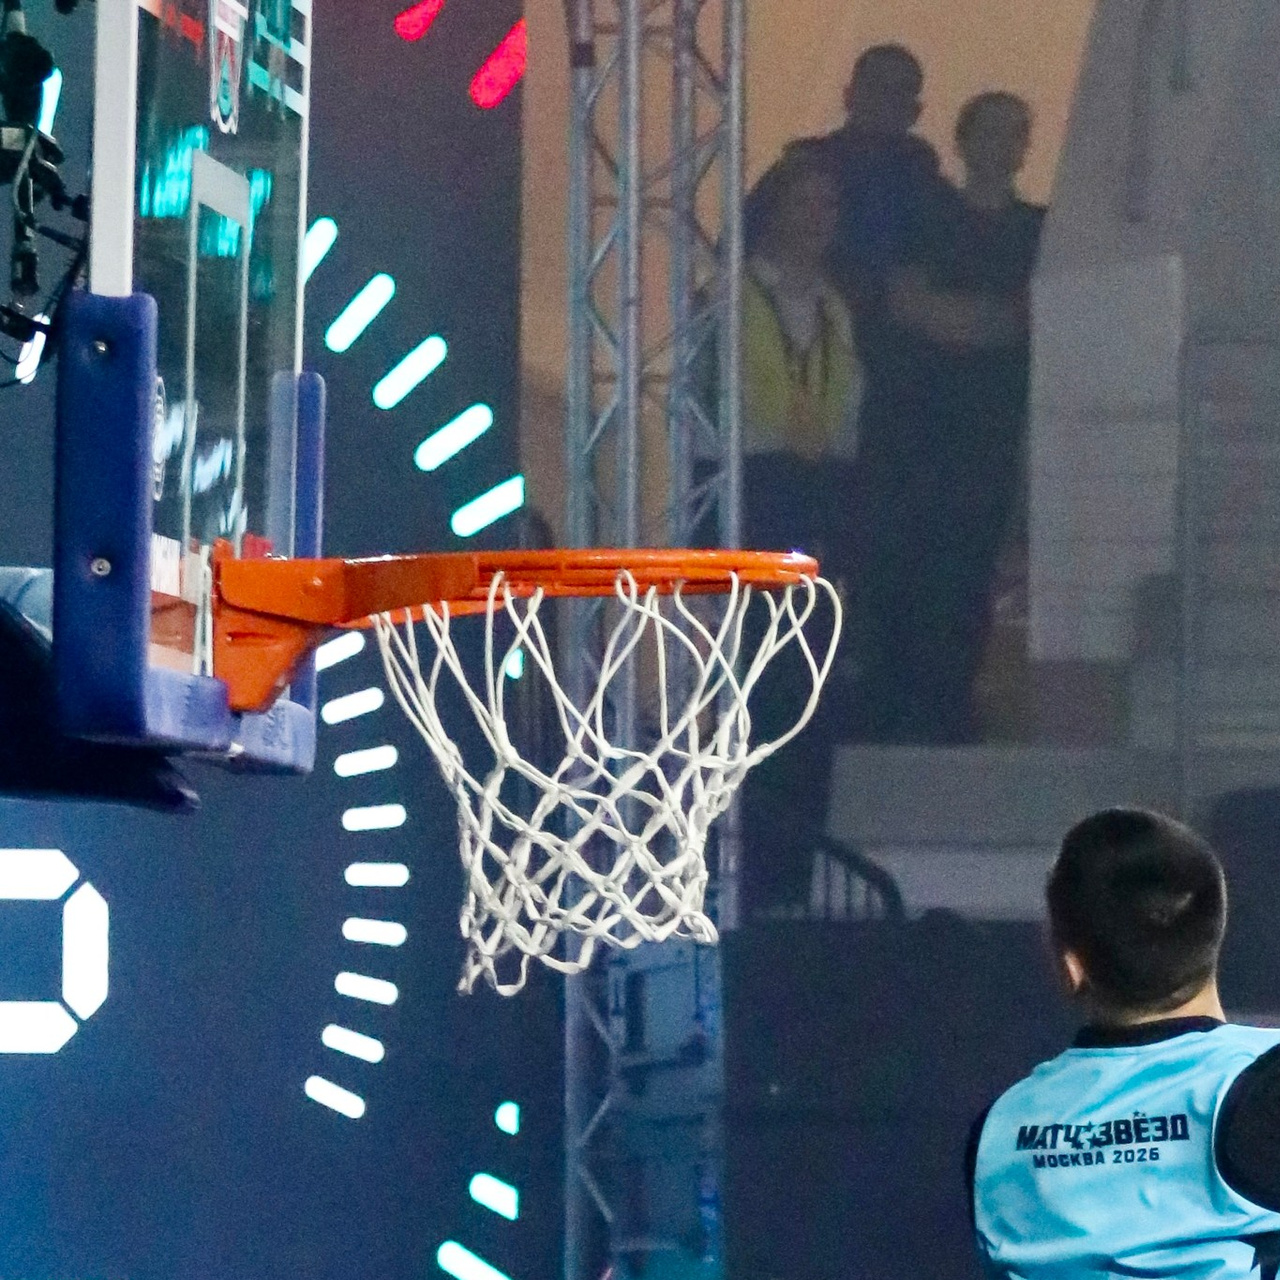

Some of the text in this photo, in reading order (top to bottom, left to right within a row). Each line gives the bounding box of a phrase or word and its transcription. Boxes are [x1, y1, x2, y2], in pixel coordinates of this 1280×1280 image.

[1016, 1123, 1085, 1151] МАТЧ
[1032, 1147, 1160, 1168] МОСКВА 2026
